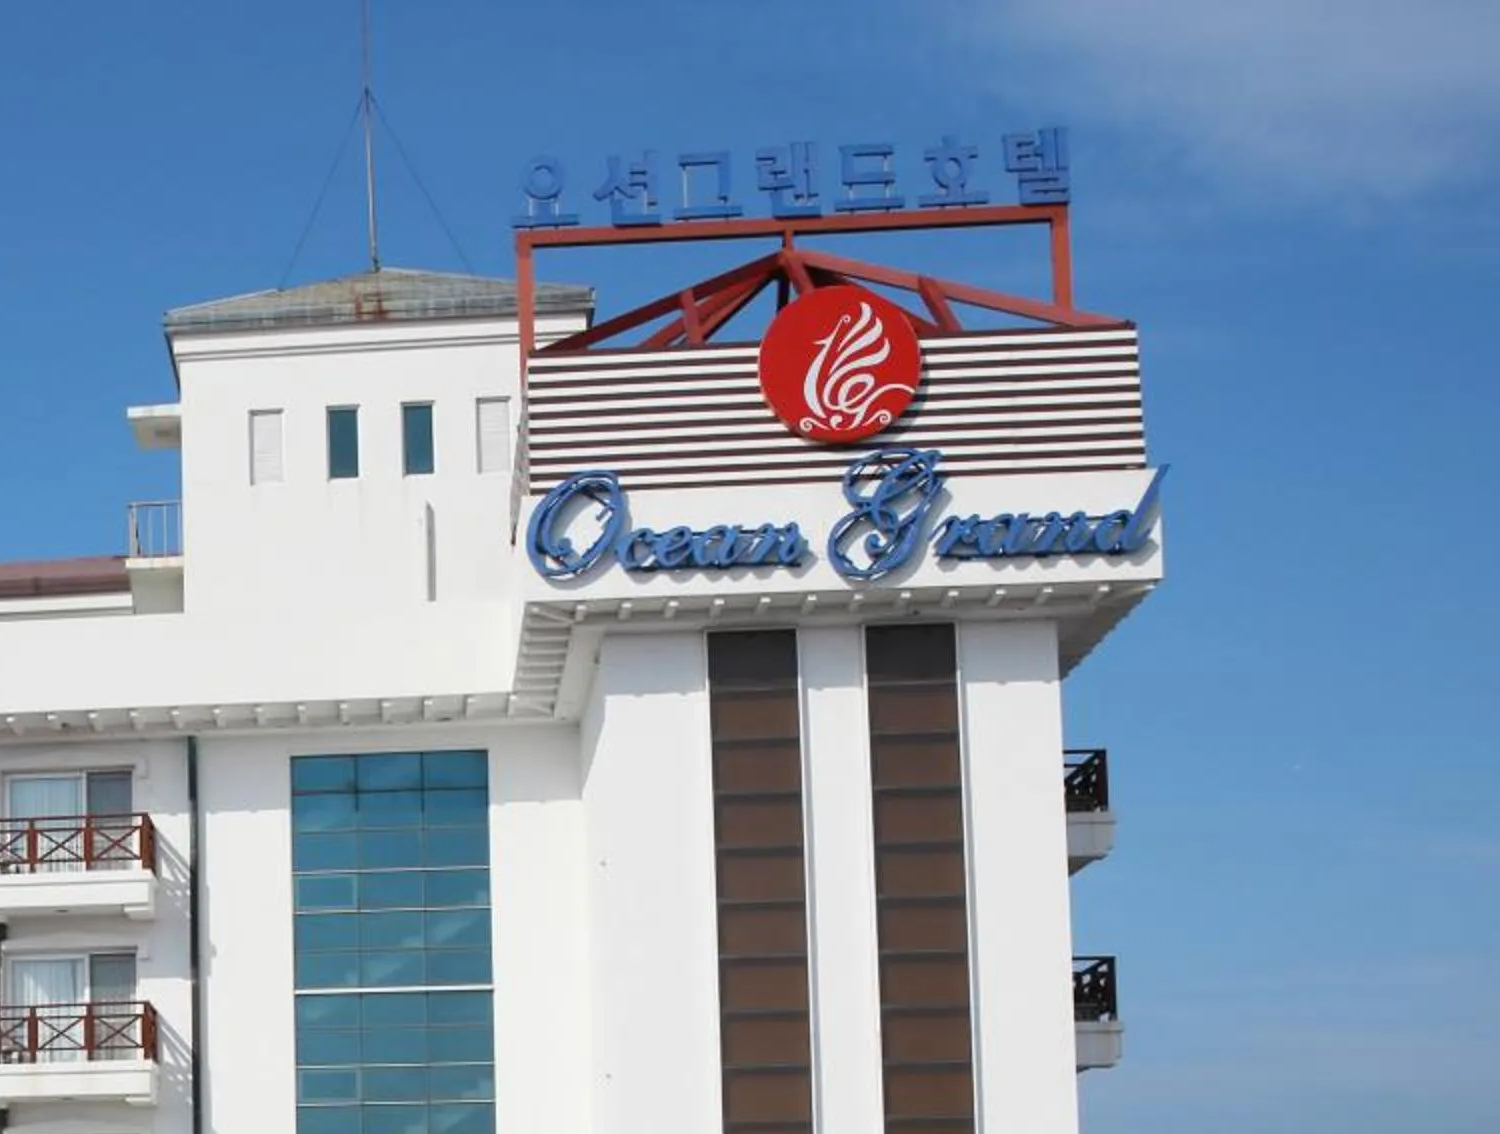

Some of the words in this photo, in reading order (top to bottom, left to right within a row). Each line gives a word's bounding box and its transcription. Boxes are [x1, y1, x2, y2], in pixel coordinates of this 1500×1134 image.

[510, 126, 1069, 228] 오션그랜드호텔
[526, 470, 803, 580] Ocean
[828, 448, 1170, 580] Grand
